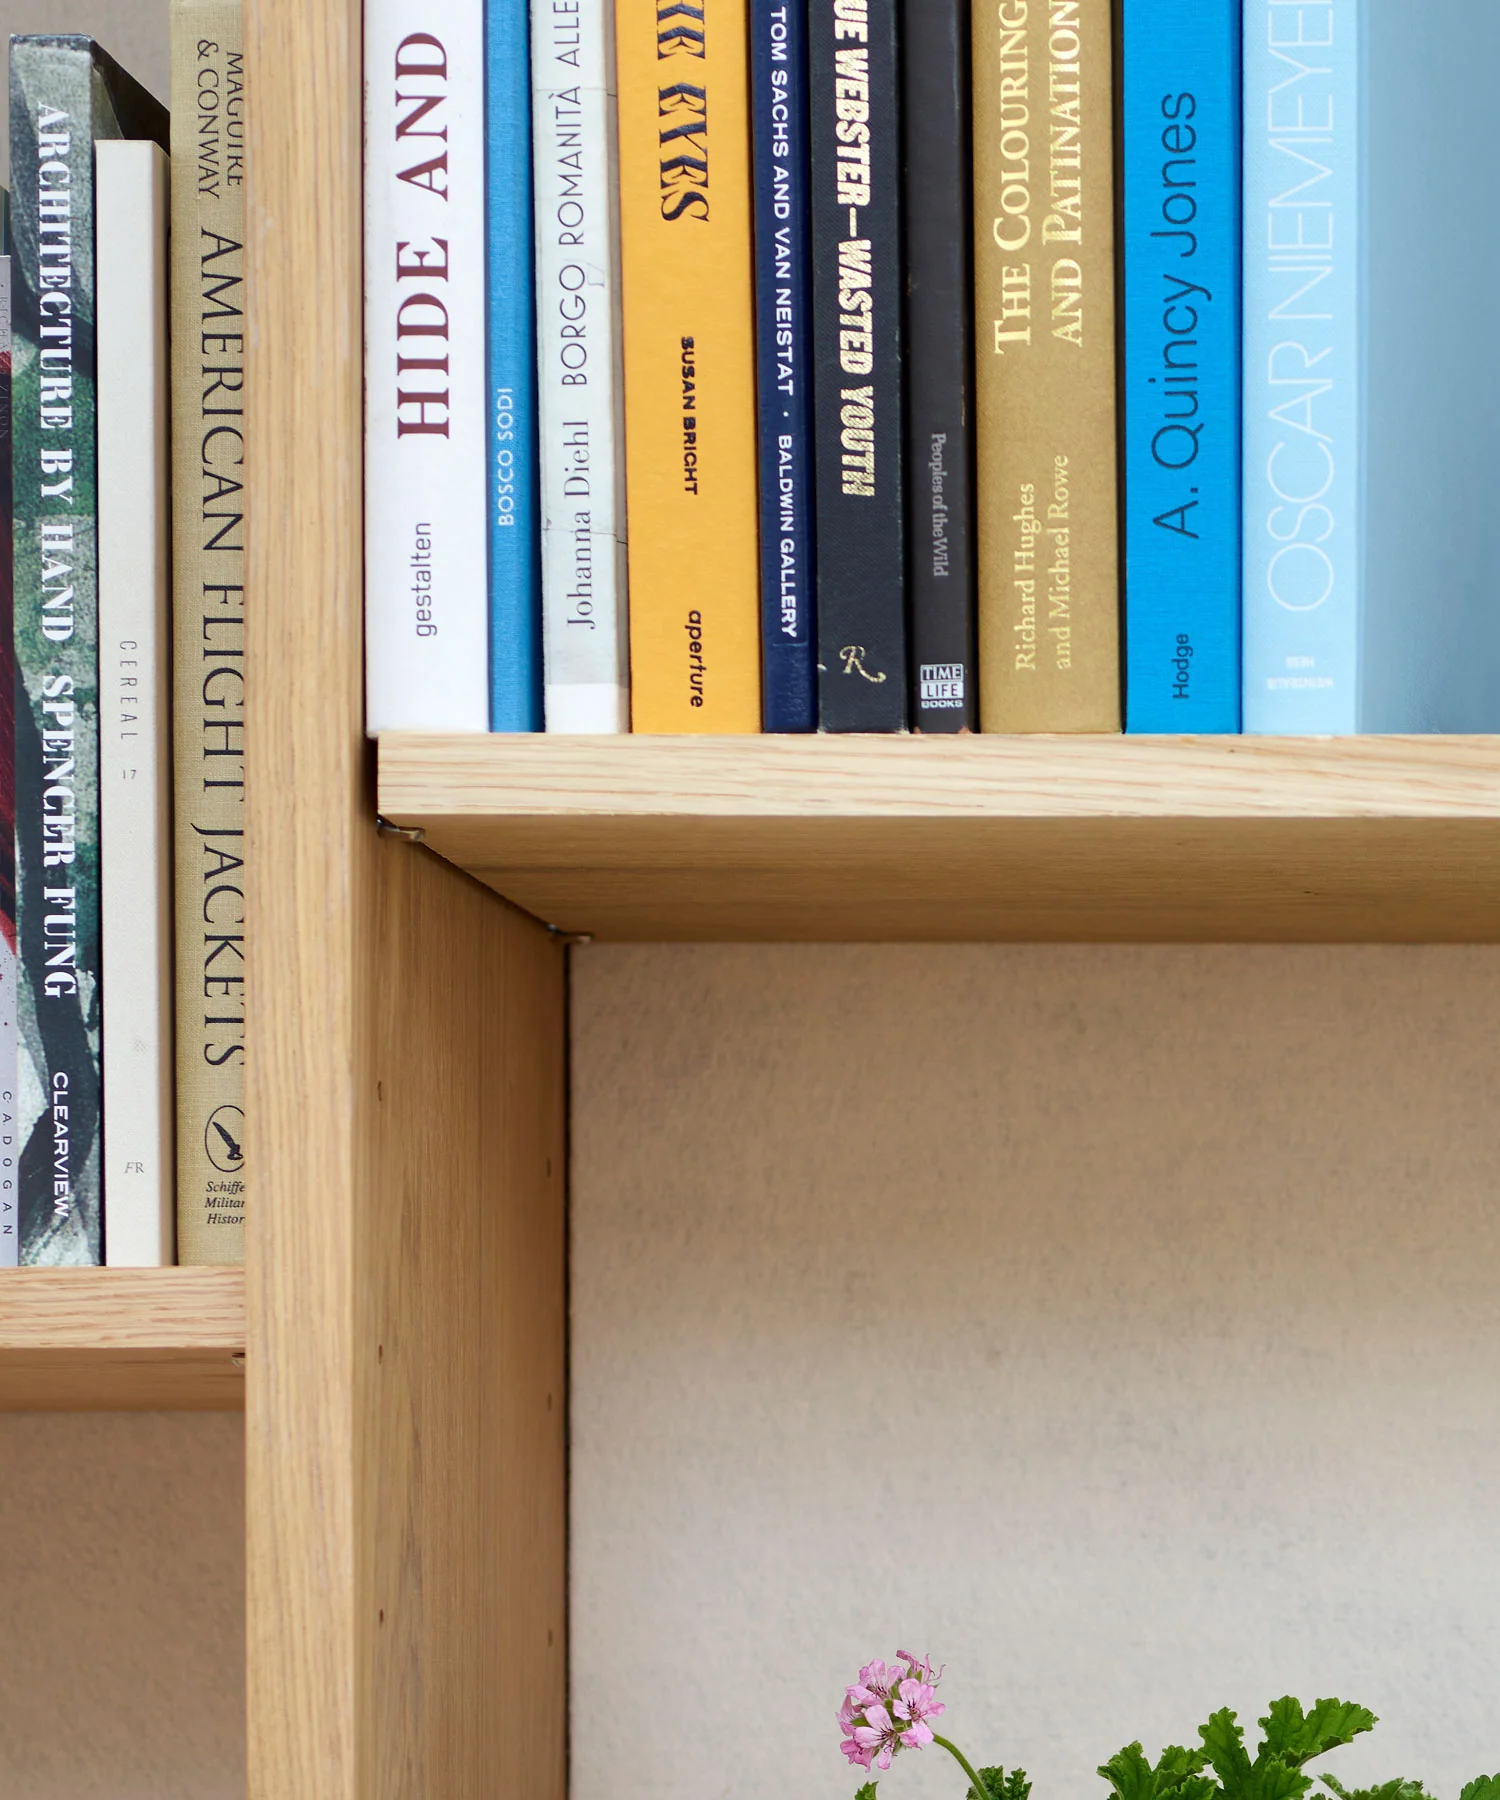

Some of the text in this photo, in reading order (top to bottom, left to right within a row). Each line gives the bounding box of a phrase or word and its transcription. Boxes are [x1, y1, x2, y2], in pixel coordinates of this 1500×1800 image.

[197, 40, 219, 199] & CONWAY
[548, 86, 586, 247] ROMANITÀ
[658, 83, 709, 222] EYES
[993, 0, 1030, 354] THE COLOURING
[1041, 0, 1082, 347] AND PATINATION
[395, 32, 450, 440] HIDE AND
[770, 7, 793, 397] TOM SACHS AND VAN NEISTAT
[559, 263, 588, 387] BORGO
[1148, 91, 1212, 539] A. Quincy Jones
[1266, 0, 1334, 612] OSCAR NIEMEYE
[201, 226, 244, 551] AMERICAN
[497, 387, 513, 527] BOSCO SODI
[563, 418, 590, 498] Diehl
[681, 336, 699, 495] SUSAN BRIGHT
[840, 386, 875, 497] YOUTH
[928, 432, 947, 493] Peoples
[931, 495, 948, 510] of
[37, 101, 76, 998] ARCHITECTURE BY HAND SPENCER FUNG
[411, 521, 437, 636] gestalten
[566, 509, 596, 630] Johanna
[778, 435, 797, 637] BALDWIN GALLERY
[932, 537, 949, 577] Wild
[1014, 482, 1041, 671] Richard Hughes
[1047, 456, 1070, 671] and Michael Rowe
[120, 641, 138, 739] CEREAL
[688, 609, 704, 708] aperture
[921, 700, 963, 708] BOOKS
[923, 666, 961, 680] TIME
[927, 683, 958, 697] LIFE
[1172, 632, 1190, 699] Hodge
[190, 823, 245, 1065] JACKETS
[2, 1091, 12, 1234] CADOGAN
[54, 1072, 68, 1216] CLEARVIEW
[206, 1181, 245, 1194] Schiffe
